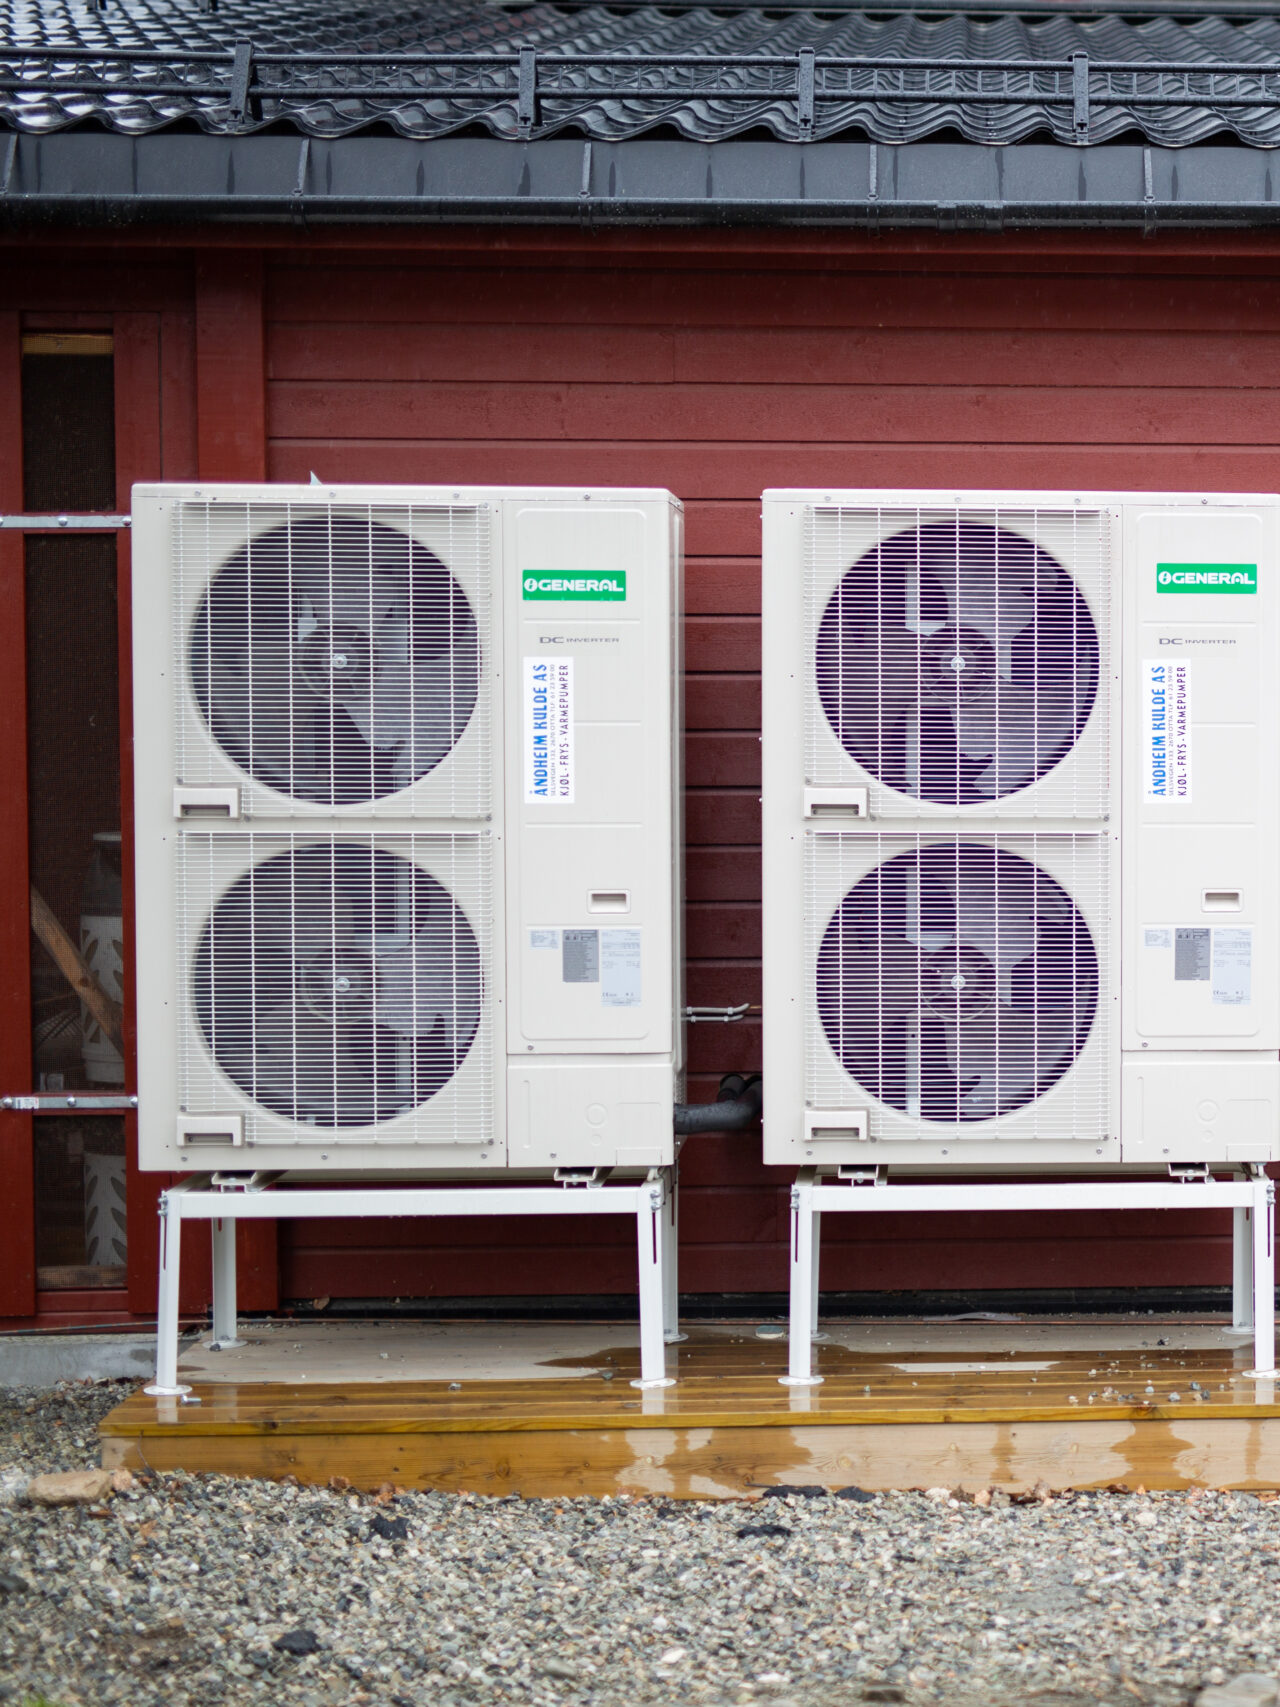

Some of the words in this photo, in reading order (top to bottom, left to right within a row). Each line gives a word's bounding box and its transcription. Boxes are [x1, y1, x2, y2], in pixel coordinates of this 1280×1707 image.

[538, 579, 624, 592] GENERAL
[1172, 572, 1255, 585] GENERAL
[539, 636, 564, 644] DC
[533, 664, 547, 682] AS
[550, 664, 556, 672] 00
[1151, 666, 1165, 683] AS
[1168, 666, 1174, 674] 00
[533, 687, 547, 730] KULDE
[559, 665, 568, 735] VARMEPUMPER
[1152, 689, 1166, 730] KULDE
[1177, 666, 1186, 736] VARMEPUMPER
[530, 734, 548, 796] ÅNDHEIM
[560, 743, 568, 765] FRYS
[1177, 744, 1186, 765] FRYS
[1148, 736, 1166, 796] ÅNDHEIM
[560, 773, 569, 796] KJØL
[1177, 773, 1187, 796] KJØL
